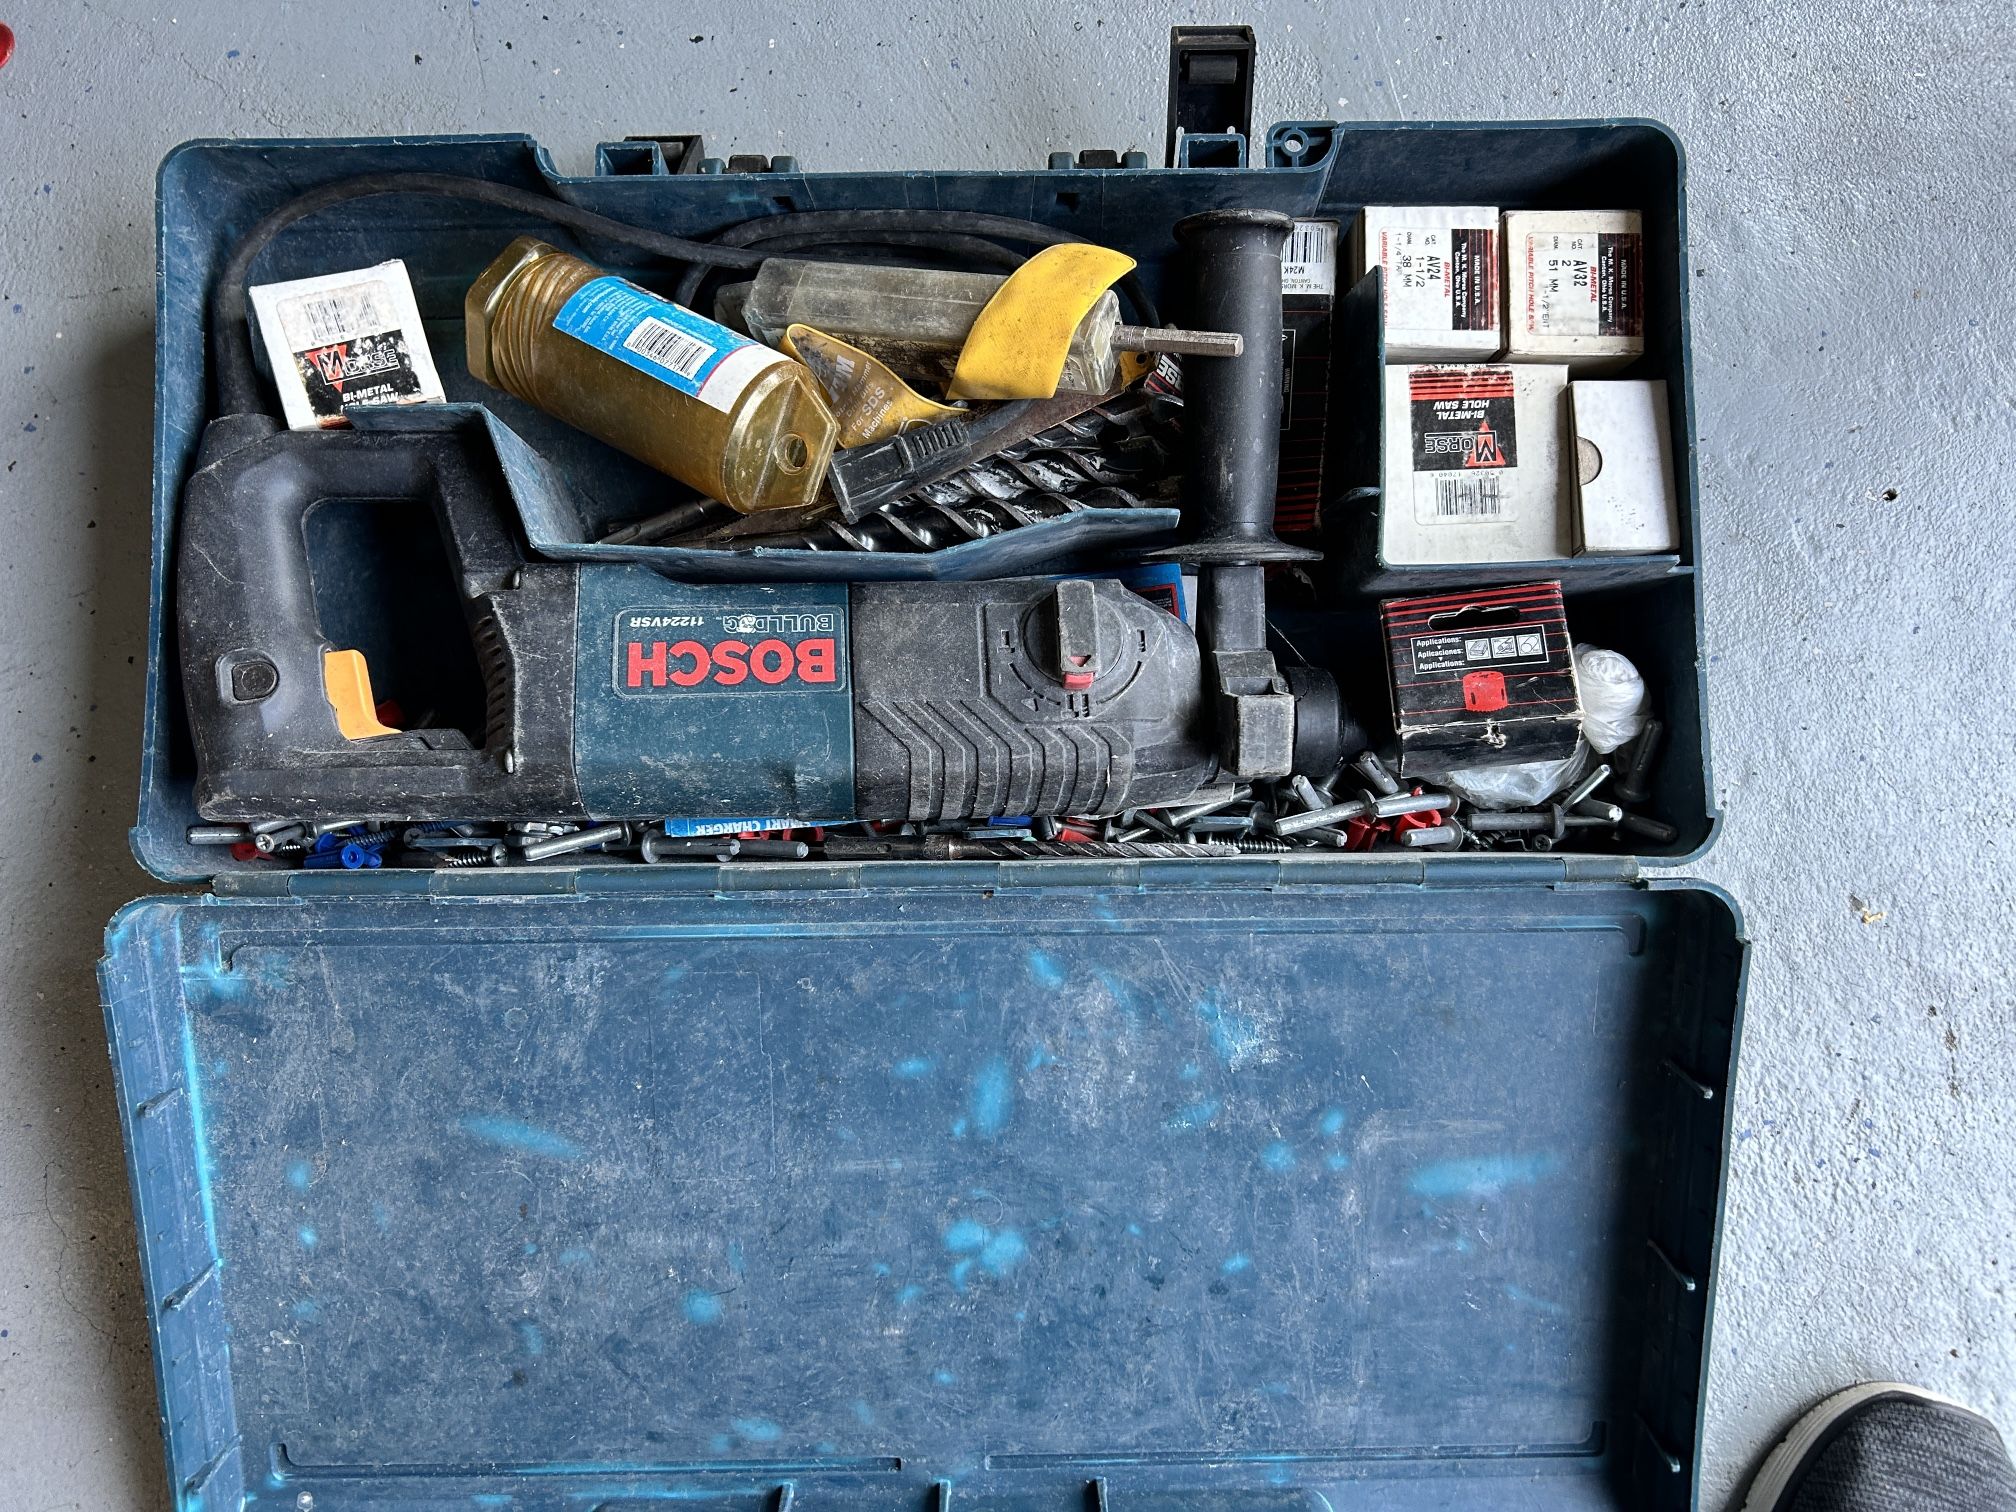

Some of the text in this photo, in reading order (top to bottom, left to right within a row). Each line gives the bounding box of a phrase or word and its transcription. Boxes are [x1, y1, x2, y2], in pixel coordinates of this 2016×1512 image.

[1402, 255, 1412, 268] 38
[1427, 255, 1441, 280] AV24
[1549, 260, 1558, 271] 51
[1608, 258, 1613, 267] M.
[1284, 266, 1305, 274] M24K
[1416, 256, 1425, 288] 1-1/2
[1573, 259, 1587, 287] AV32
[1402, 274, 1412, 288] MM
[1474, 276, 1481, 285] IN
[1549, 279, 1558, 292] MM
[342, 383, 394, 403] BI-METAL
[851, 386, 885, 431] For SDS
[1433, 400, 1490, 410] HOLE SAW
[862, 399, 893, 439] Machines
[1436, 410, 1485, 420] BI-METAL
[1425, 431, 1497, 463] MORSE
[630, 616, 704, 628] 11224VSR
[1416, 636, 1462, 647] Applications:
[1417, 648, 1464, 659] Aplicaciones:
[627, 638, 836, 687] BOSCH
[1419, 659, 1465, 671] Applications:
[696, 818, 760, 835] CHARGER
